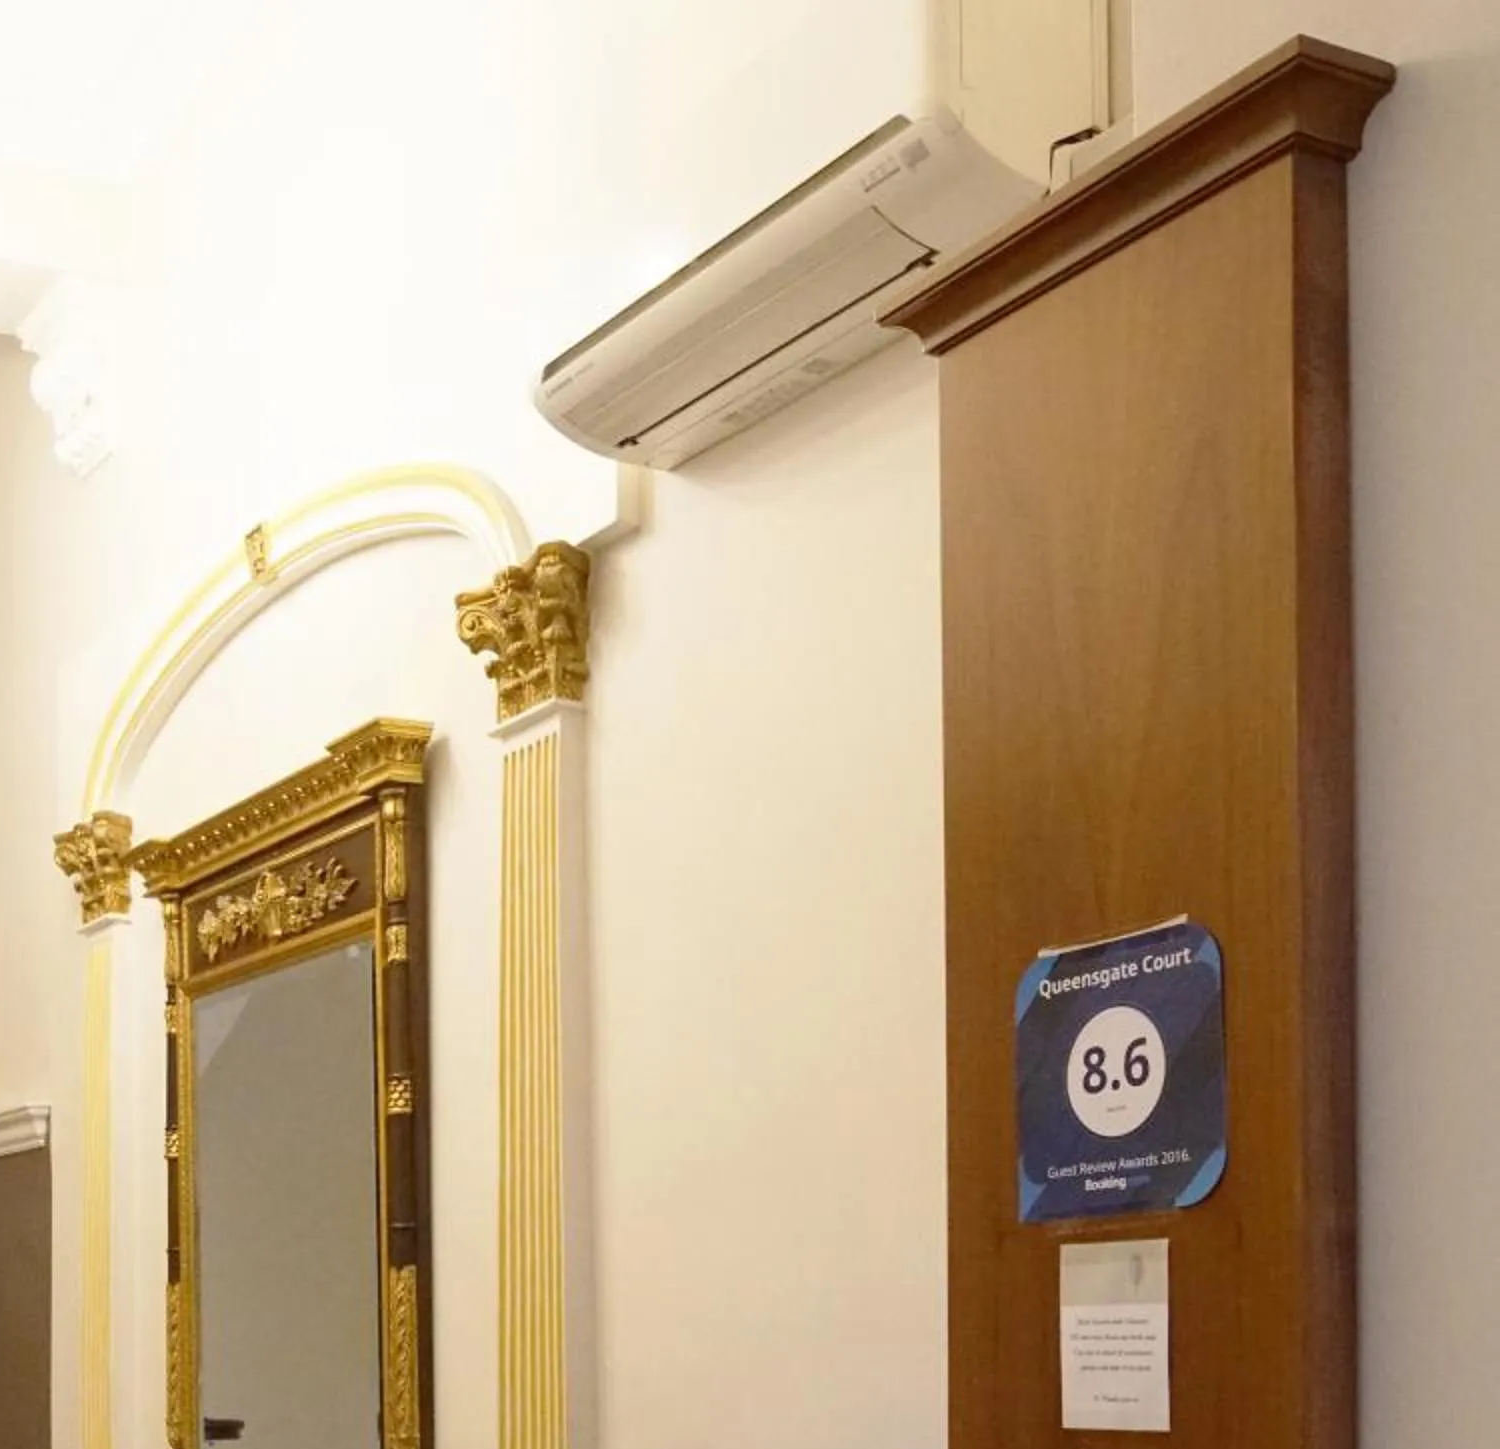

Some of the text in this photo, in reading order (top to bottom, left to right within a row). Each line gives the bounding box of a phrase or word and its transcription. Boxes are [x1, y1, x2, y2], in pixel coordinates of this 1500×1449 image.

[1039, 948, 1192, 999] Queensgate Court
[1083, 1037, 1149, 1094] 8.6
[1047, 1164, 1077, 1178] Guest
[1079, 1161, 1117, 1176] Review
[1118, 1154, 1158, 1170] Awards
